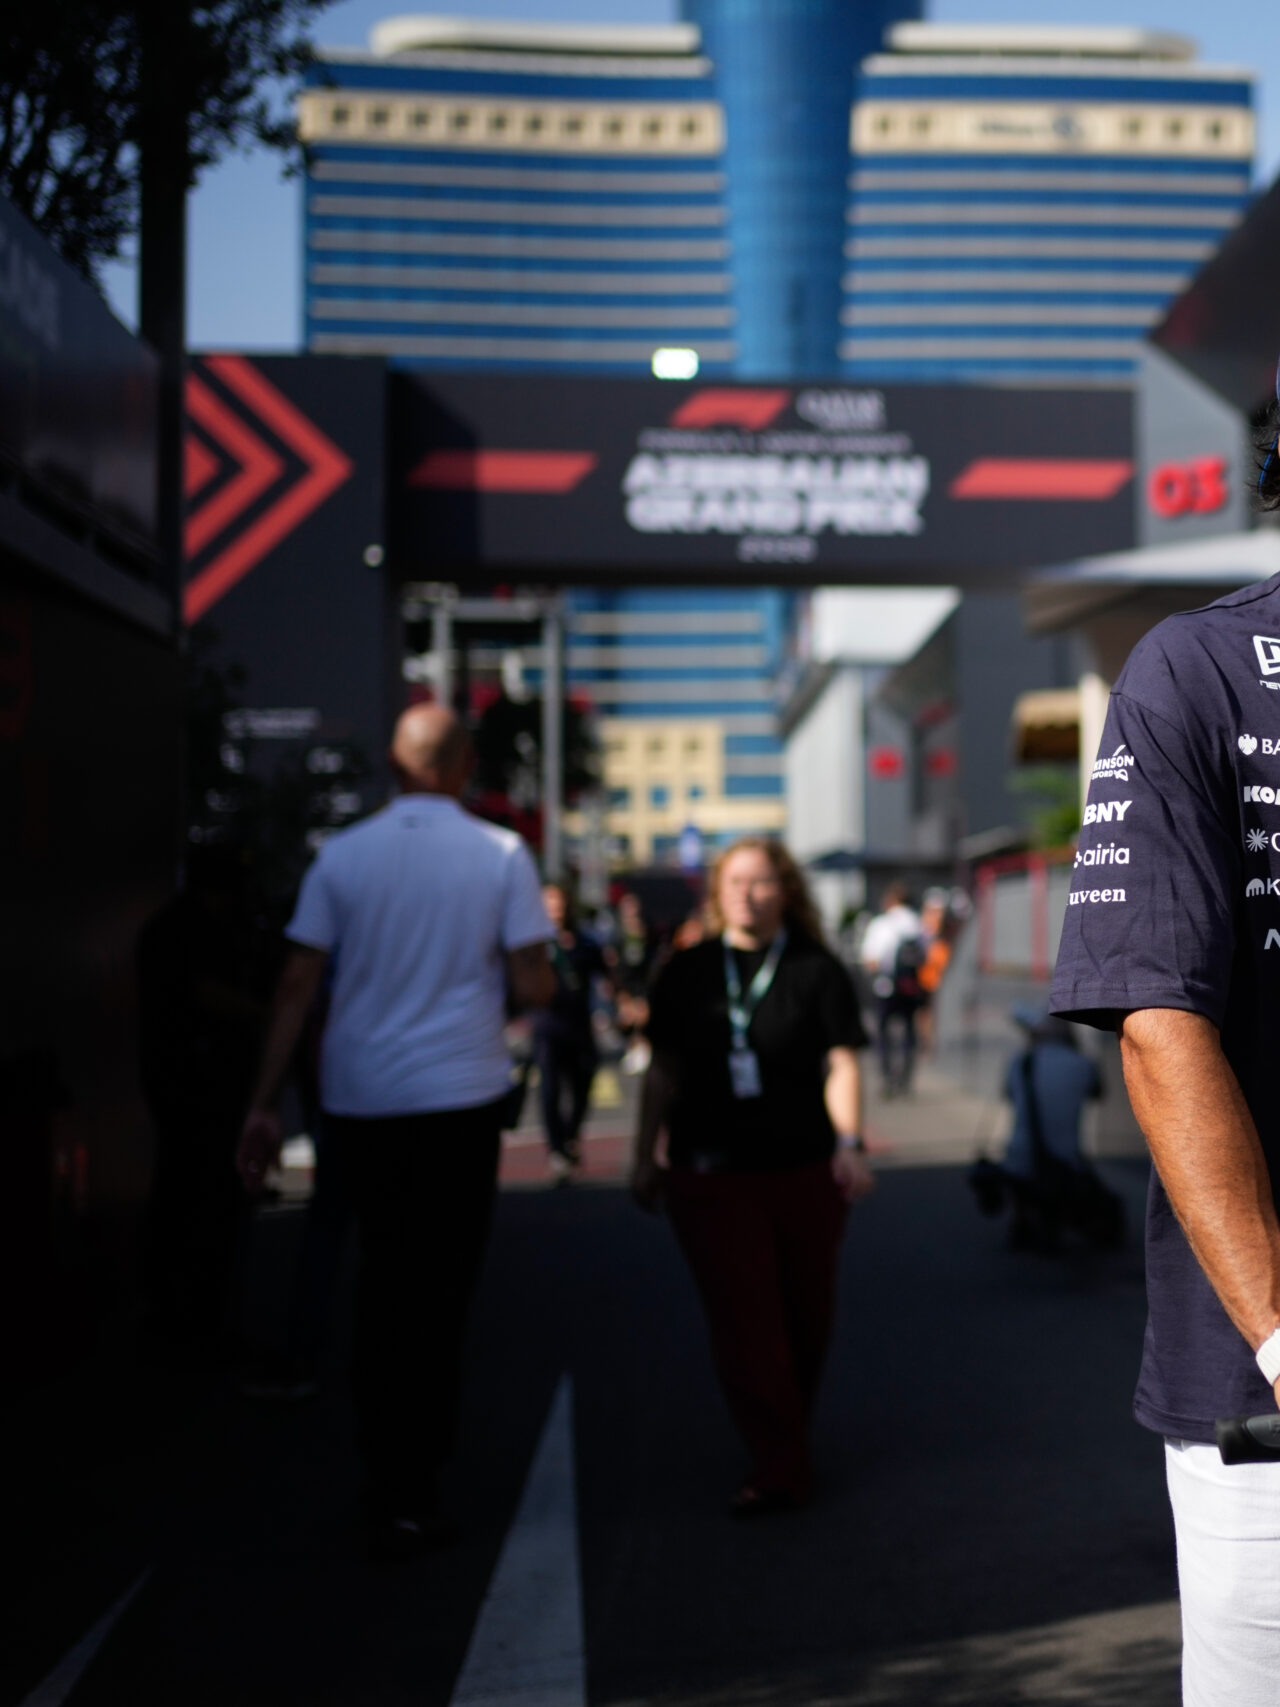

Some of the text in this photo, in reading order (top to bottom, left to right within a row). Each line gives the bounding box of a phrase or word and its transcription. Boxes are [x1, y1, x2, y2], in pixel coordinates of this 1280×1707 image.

[1082, 801, 1133, 826] BNY
[1083, 843, 1131, 866] airia
[1067, 888, 1128, 905] uveen
